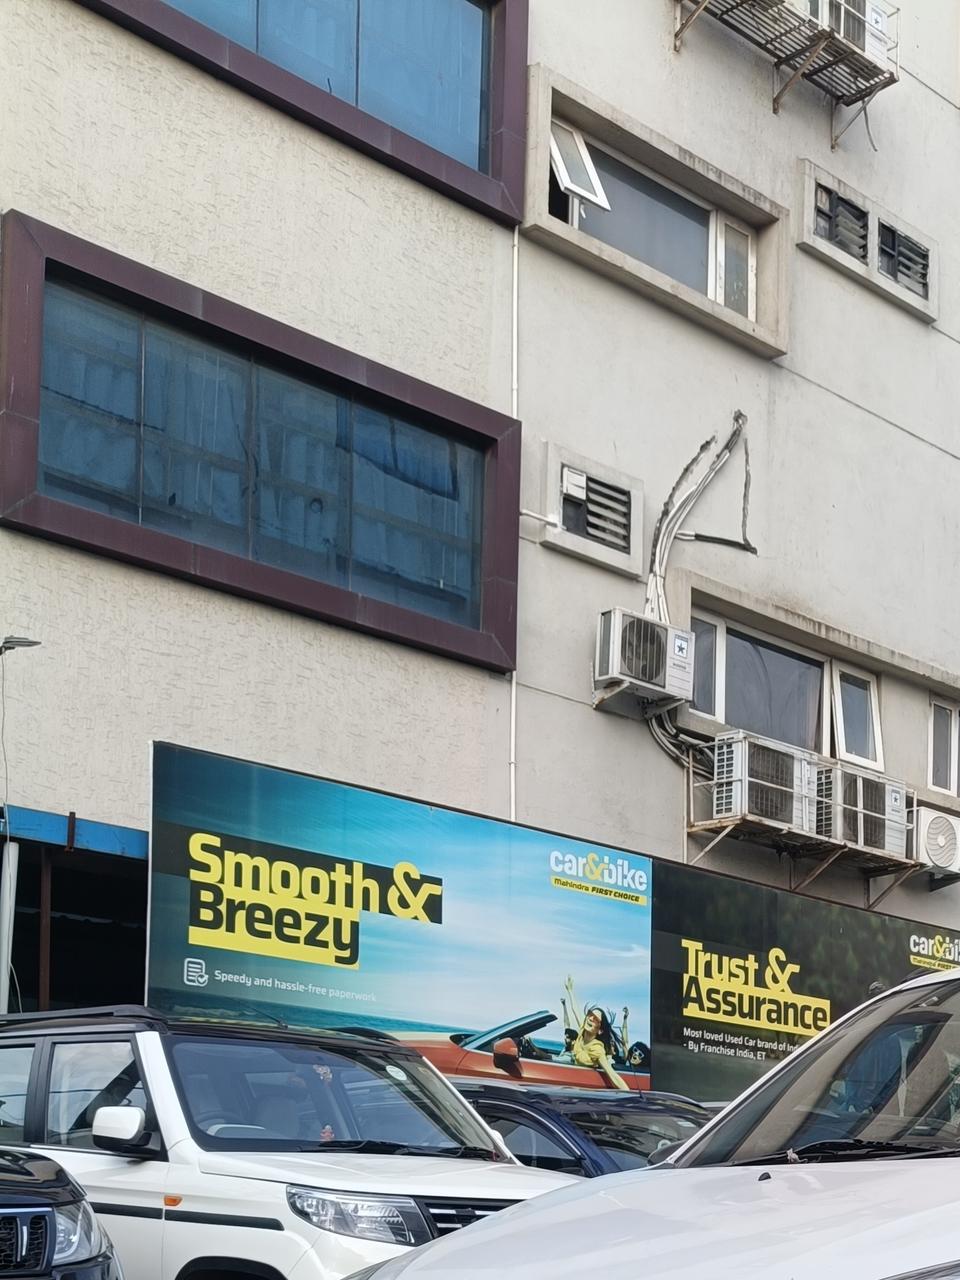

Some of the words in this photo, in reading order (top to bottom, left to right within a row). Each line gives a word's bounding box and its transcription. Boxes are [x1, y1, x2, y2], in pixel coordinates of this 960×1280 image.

[189, 833, 379, 913] Smooth
[388, 861, 442, 923] &
[550, 851, 647, 891] car&bike
[591, 886, 613, 897] FIRST
[613, 891, 640, 902] CHOICE
[190, 880, 359, 965] Breezy
[681, 938, 758, 987] Trust
[765, 947, 800, 993] &
[214, 970, 251, 986] Speedy
[254, 976, 273, 988] and
[275, 978, 327, 996] hassle-free
[328, 988, 377, 1002] paperwork
[682, 976, 828, 1031] Assurance
[683, 1027, 702, 1038] Most
[704, 1029, 724, 1042] loved
[725, 1032, 743, 1045] Used
[744, 1037, 756, 1047] Car
[757, 1037, 778, 1050] brand
[779, 1041, 787, 1051] of
[688, 1041, 699, 1053] By
[700, 1042, 735, 1056] Franchise
[736, 1046, 756, 1060] India,
[757, 1050, 767, 1061] ET
